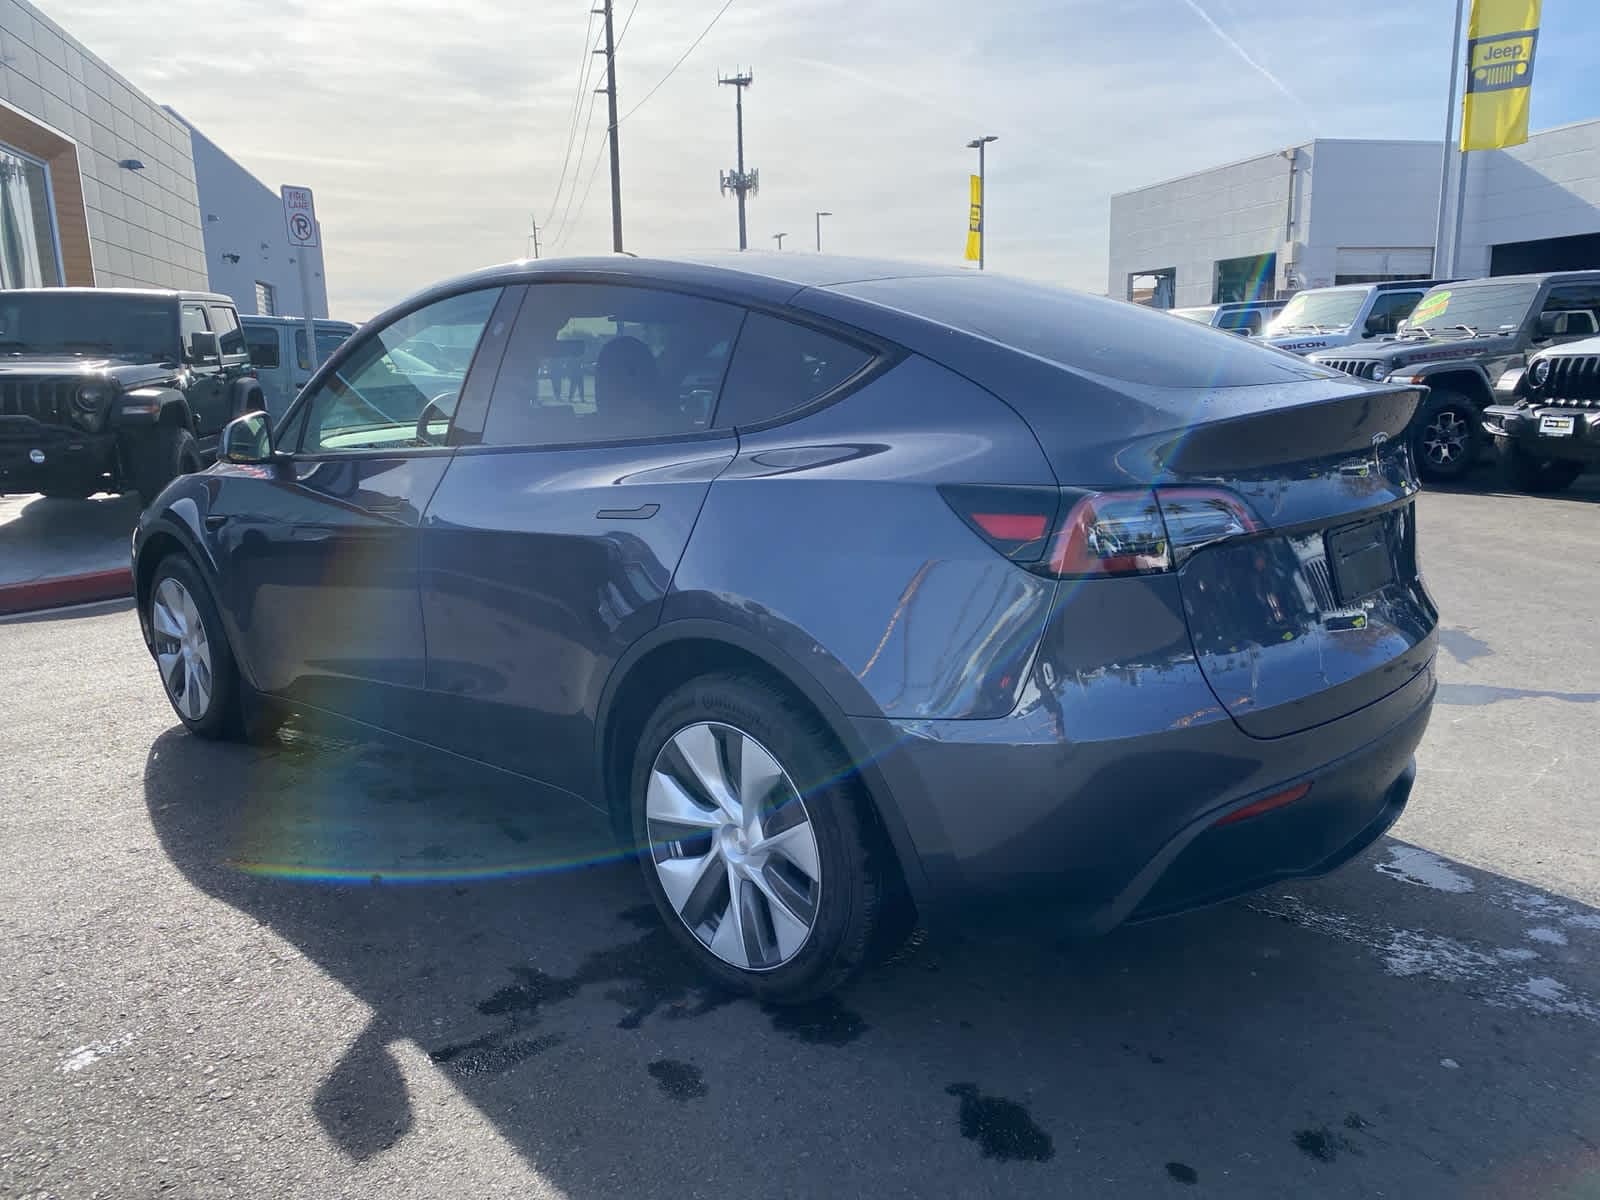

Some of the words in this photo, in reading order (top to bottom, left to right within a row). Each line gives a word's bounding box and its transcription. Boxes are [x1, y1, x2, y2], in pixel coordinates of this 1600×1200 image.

[1483, 44, 1523, 60] Jeep
[288, 191, 306, 200] FIRE
[288, 200, 309, 209] LANE
